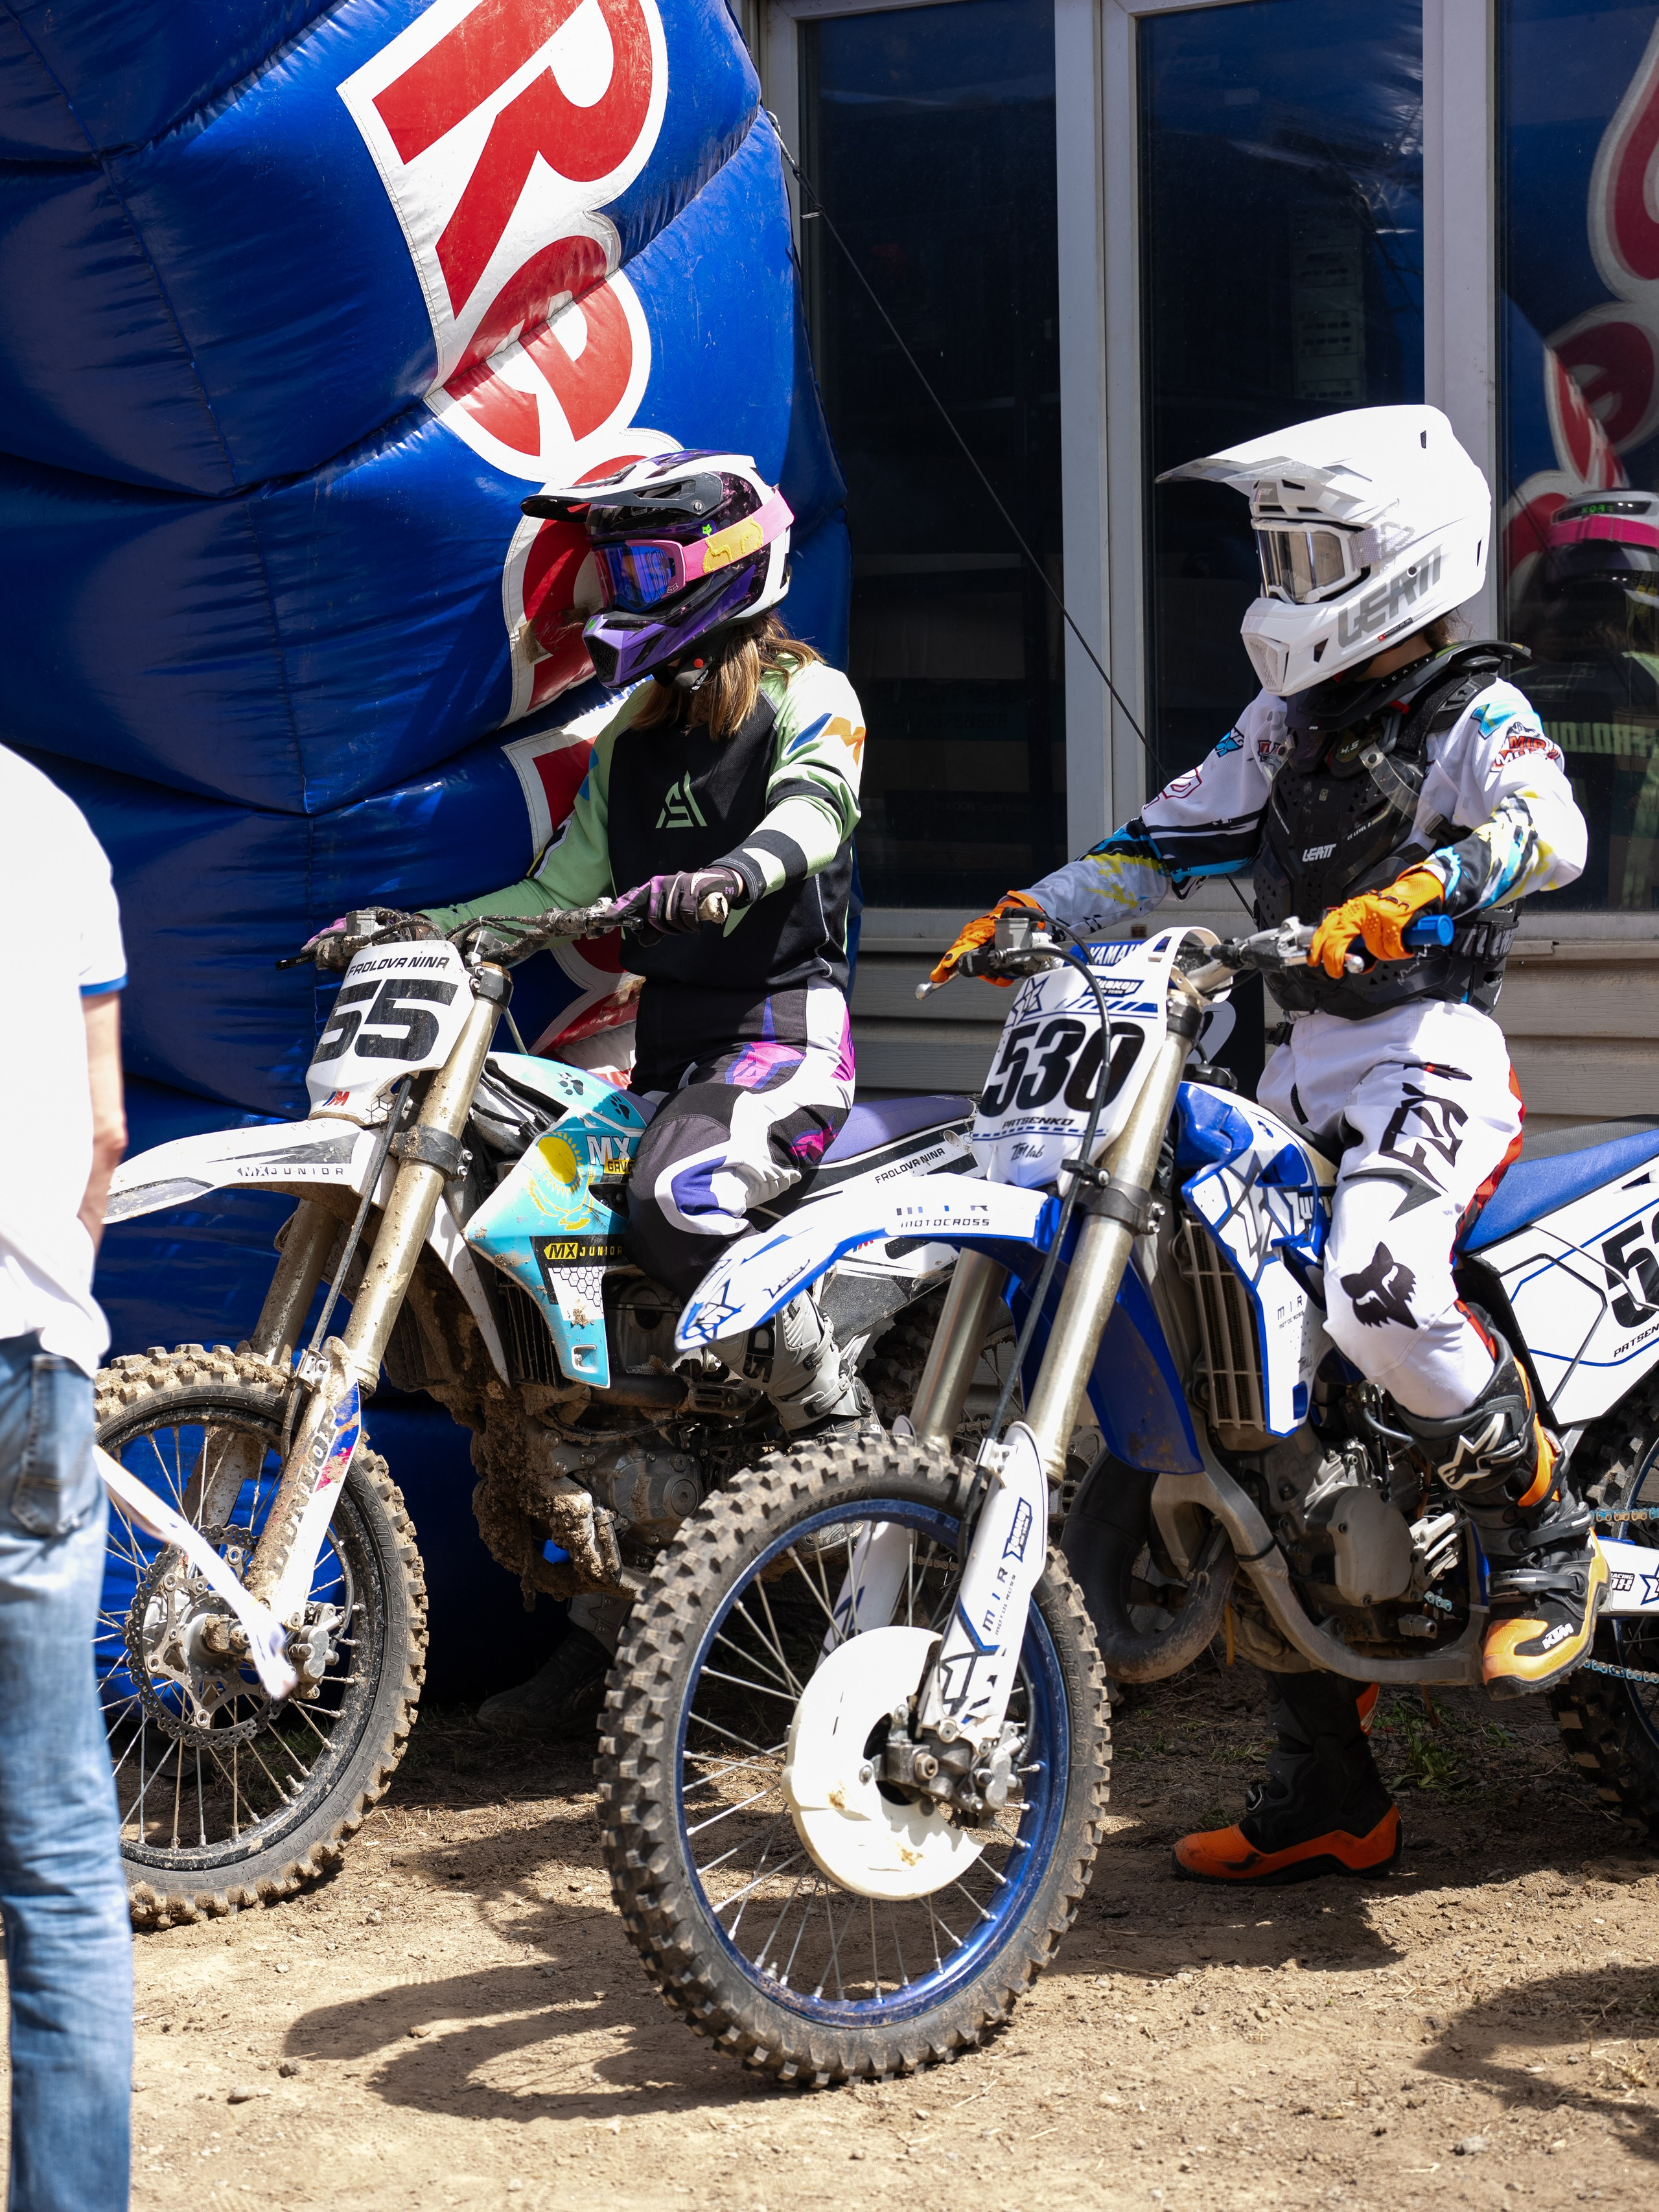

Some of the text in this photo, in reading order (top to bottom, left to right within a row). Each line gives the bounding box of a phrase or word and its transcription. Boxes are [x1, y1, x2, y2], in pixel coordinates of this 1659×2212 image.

[1338, 543, 1443, 648] LEATT
[1341, 739, 1360, 754] 4.5
[1302, 843, 1337, 862] LEATT
[347, 957, 450, 978] FROLOVA NINA
[311, 979, 459, 1065] 55
[979, 1018, 1145, 1118] 530
[1002, 1117, 1074, 1129] PATSENKO
[586, 1135, 634, 1166] MX
[875, 1148, 946, 1183] FROLOVA NINA
[901, 1218, 990, 1228] MOTOCROSS
[548, 1244, 623, 1259] MX JUNIOR
[1277, 1295, 1303, 1320] MIR
[982, 1566, 1008, 1632] MIR
[1542, 1622, 1574, 1649] KTM
[248, 1798, 345, 1877] 80/100-21
